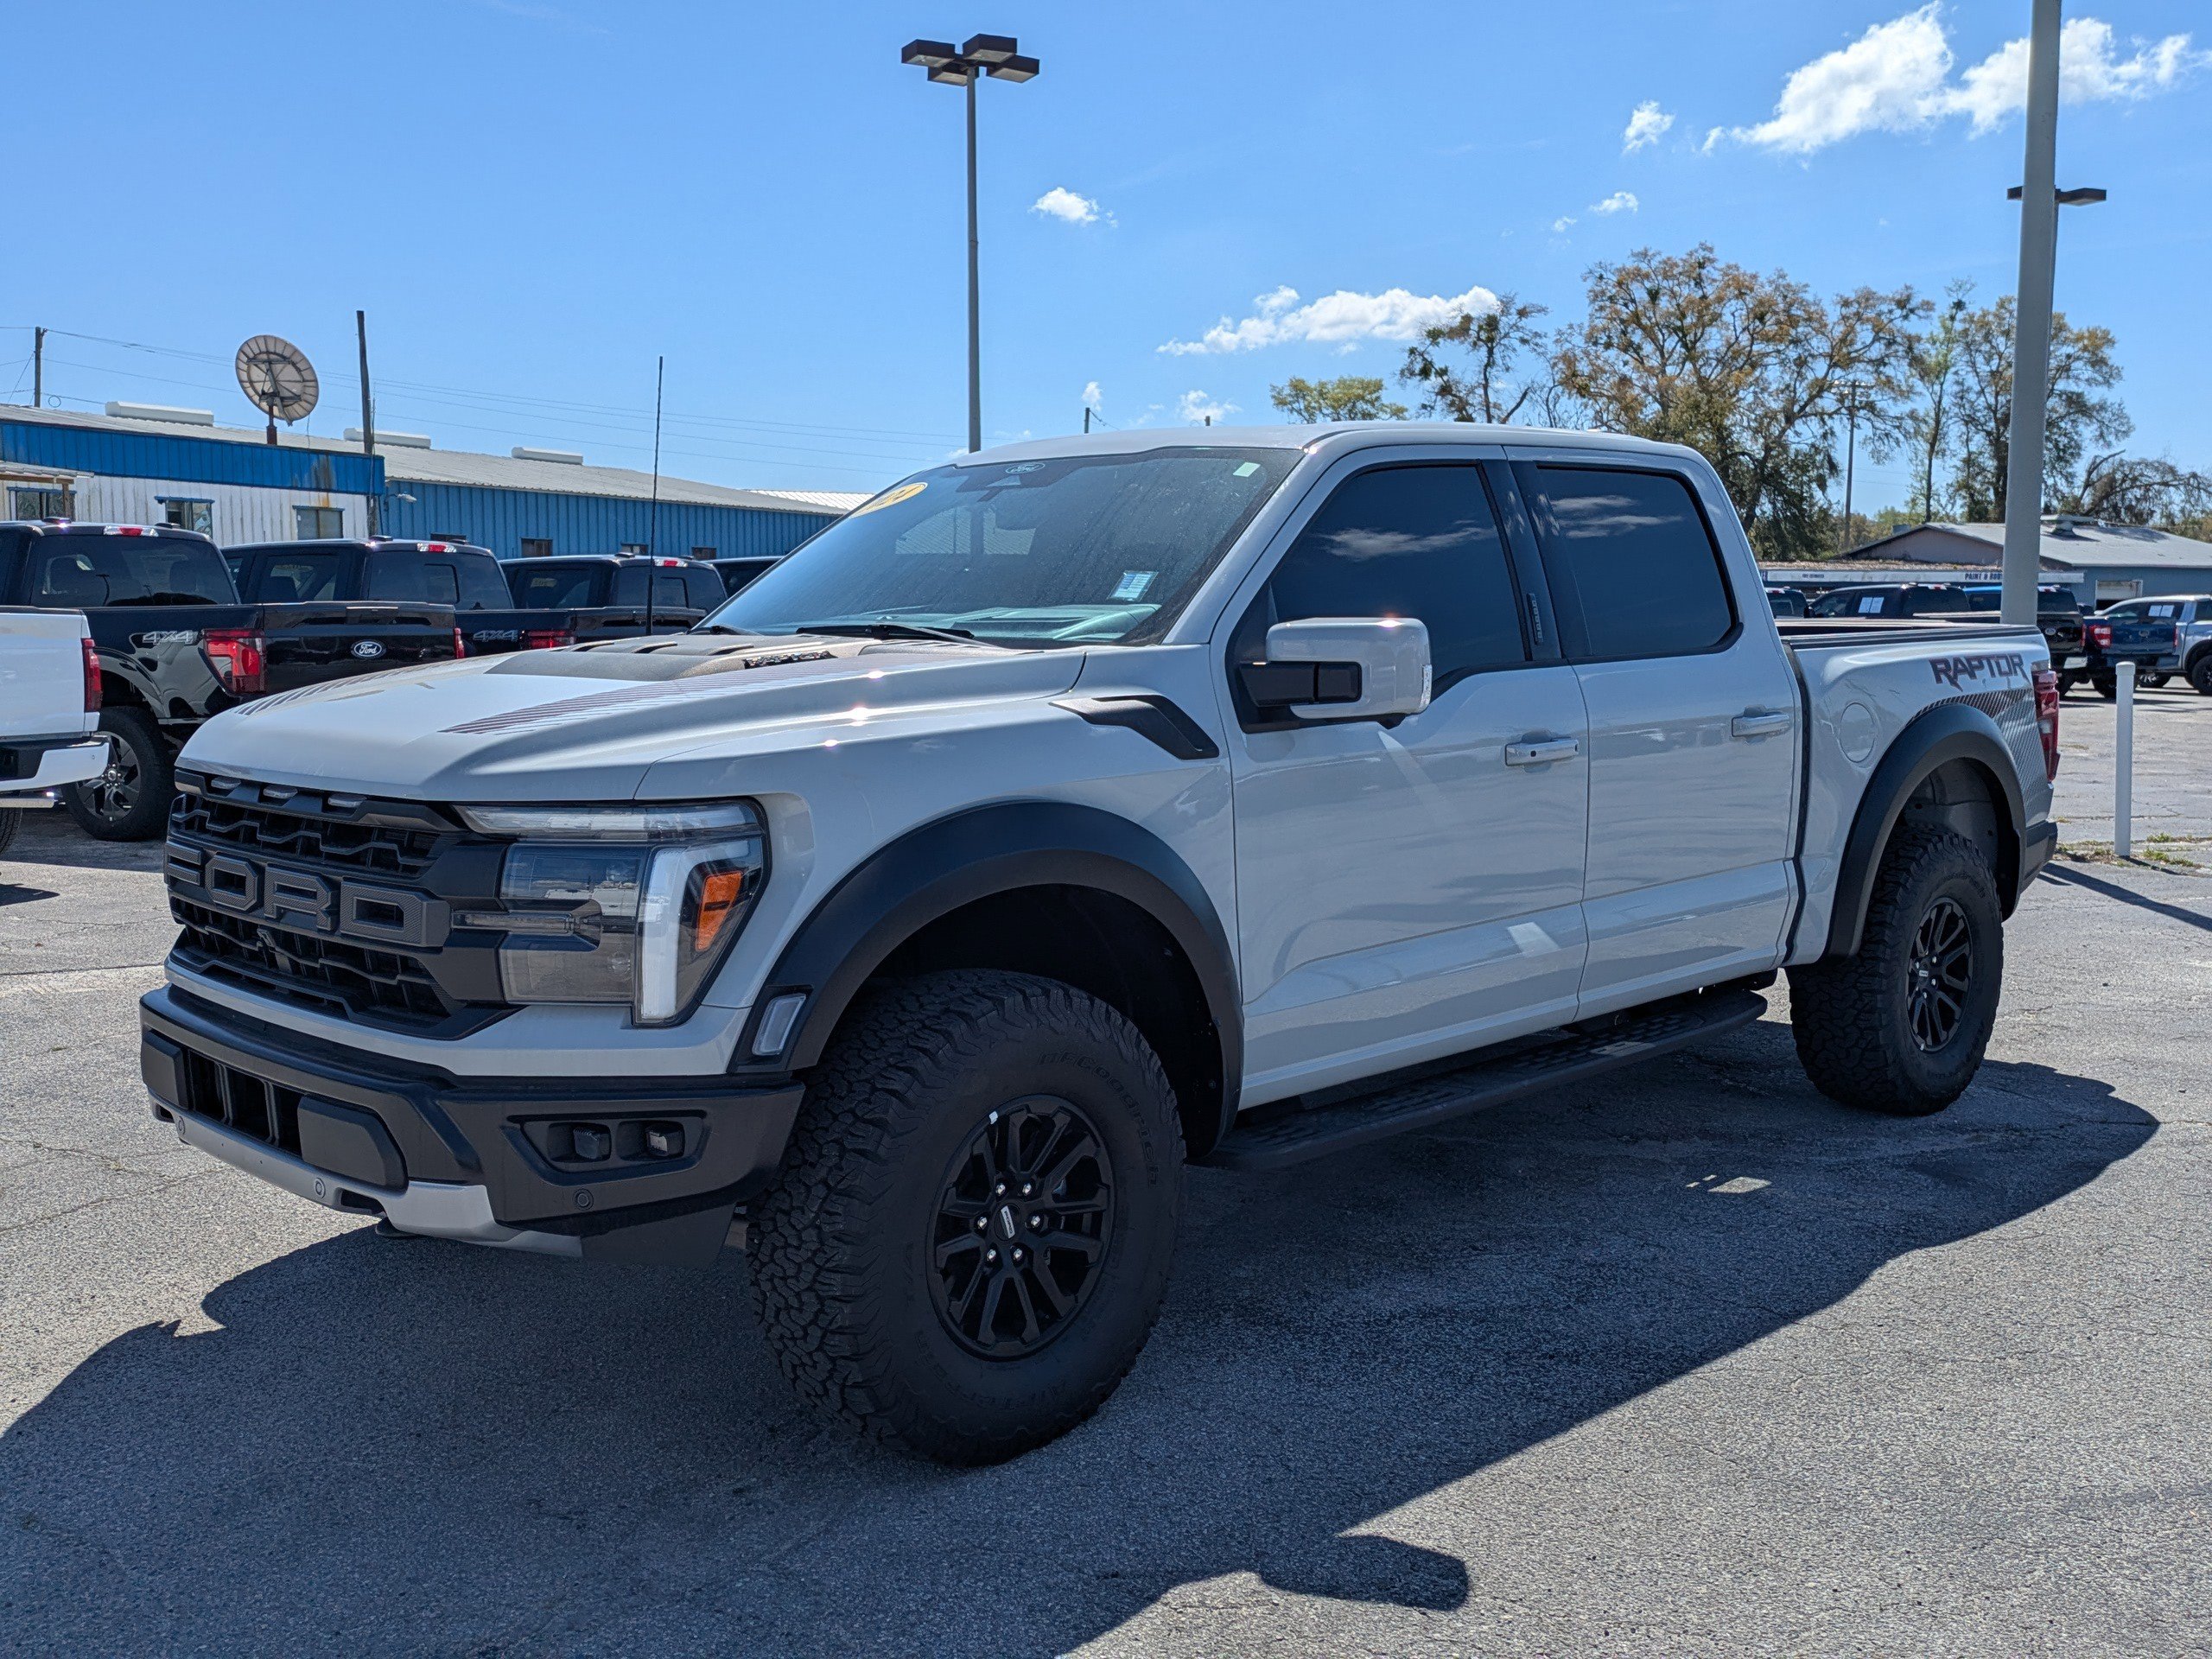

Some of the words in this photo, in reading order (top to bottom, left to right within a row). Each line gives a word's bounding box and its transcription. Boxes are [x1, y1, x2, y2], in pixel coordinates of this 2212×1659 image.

[359, 642, 378, 654] Ford
[1929, 653, 2030, 692] RAPTOR
[163, 840, 448, 948] FORD
